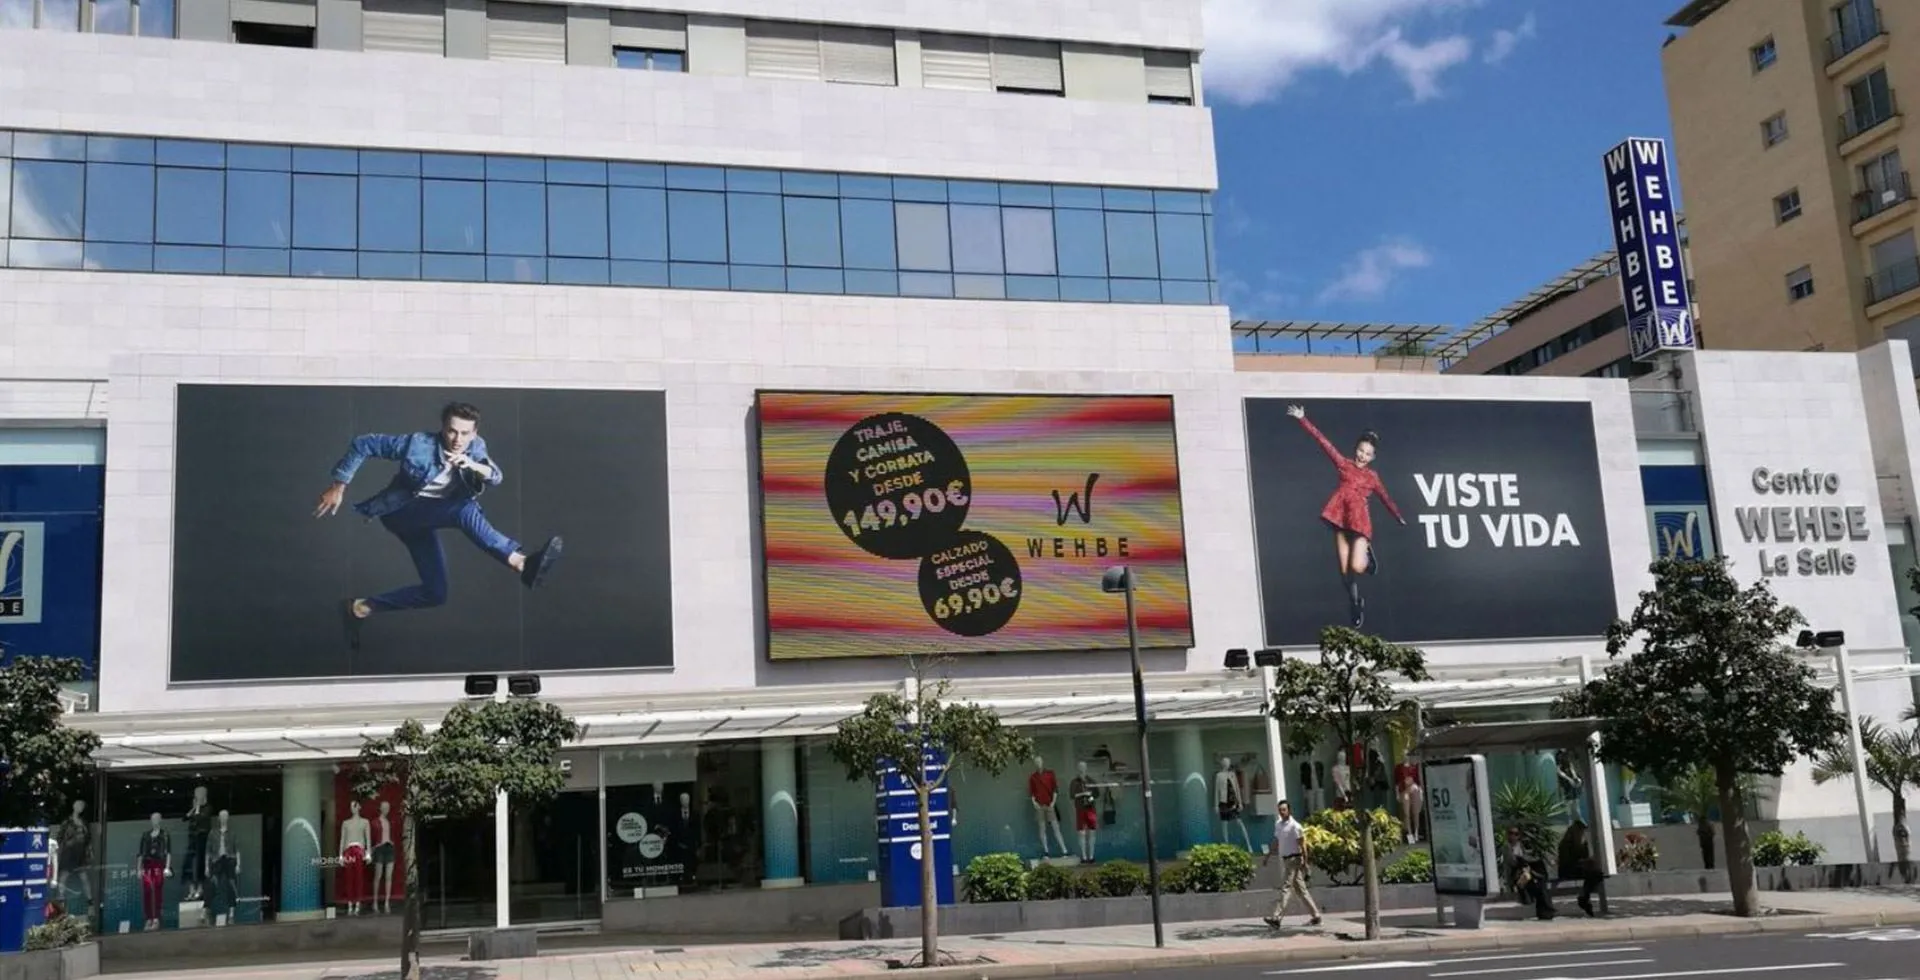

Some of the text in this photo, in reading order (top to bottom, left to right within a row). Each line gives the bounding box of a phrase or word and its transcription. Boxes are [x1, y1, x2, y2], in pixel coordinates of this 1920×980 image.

[1606, 144, 1647, 313] WEHBE
[1635, 141, 1680, 305] WEHBE
[854, 420, 909, 443] TRAJE,
[856, 435, 918, 462] CAMISA
[848, 450, 936, 483] Y CORBATA
[1751, 466, 1841, 496] Centro
[872, 471, 925, 497] DESDE
[1413, 472, 1521, 508] VISTE
[843, 479, 969, 537] 149,90€
[1418, 513, 1581, 548] TU VIDA
[1735, 506, 1871, 544] WEHBE
[931, 541, 989, 565] CALZADO
[1026, 537, 1130, 558] WEHBE
[1759, 547, 1857, 577] La Salle
[935, 554, 995, 580] ESPECIAL
[949, 570, 990, 591] DESDE
[1431, 787, 1450, 808] 50
